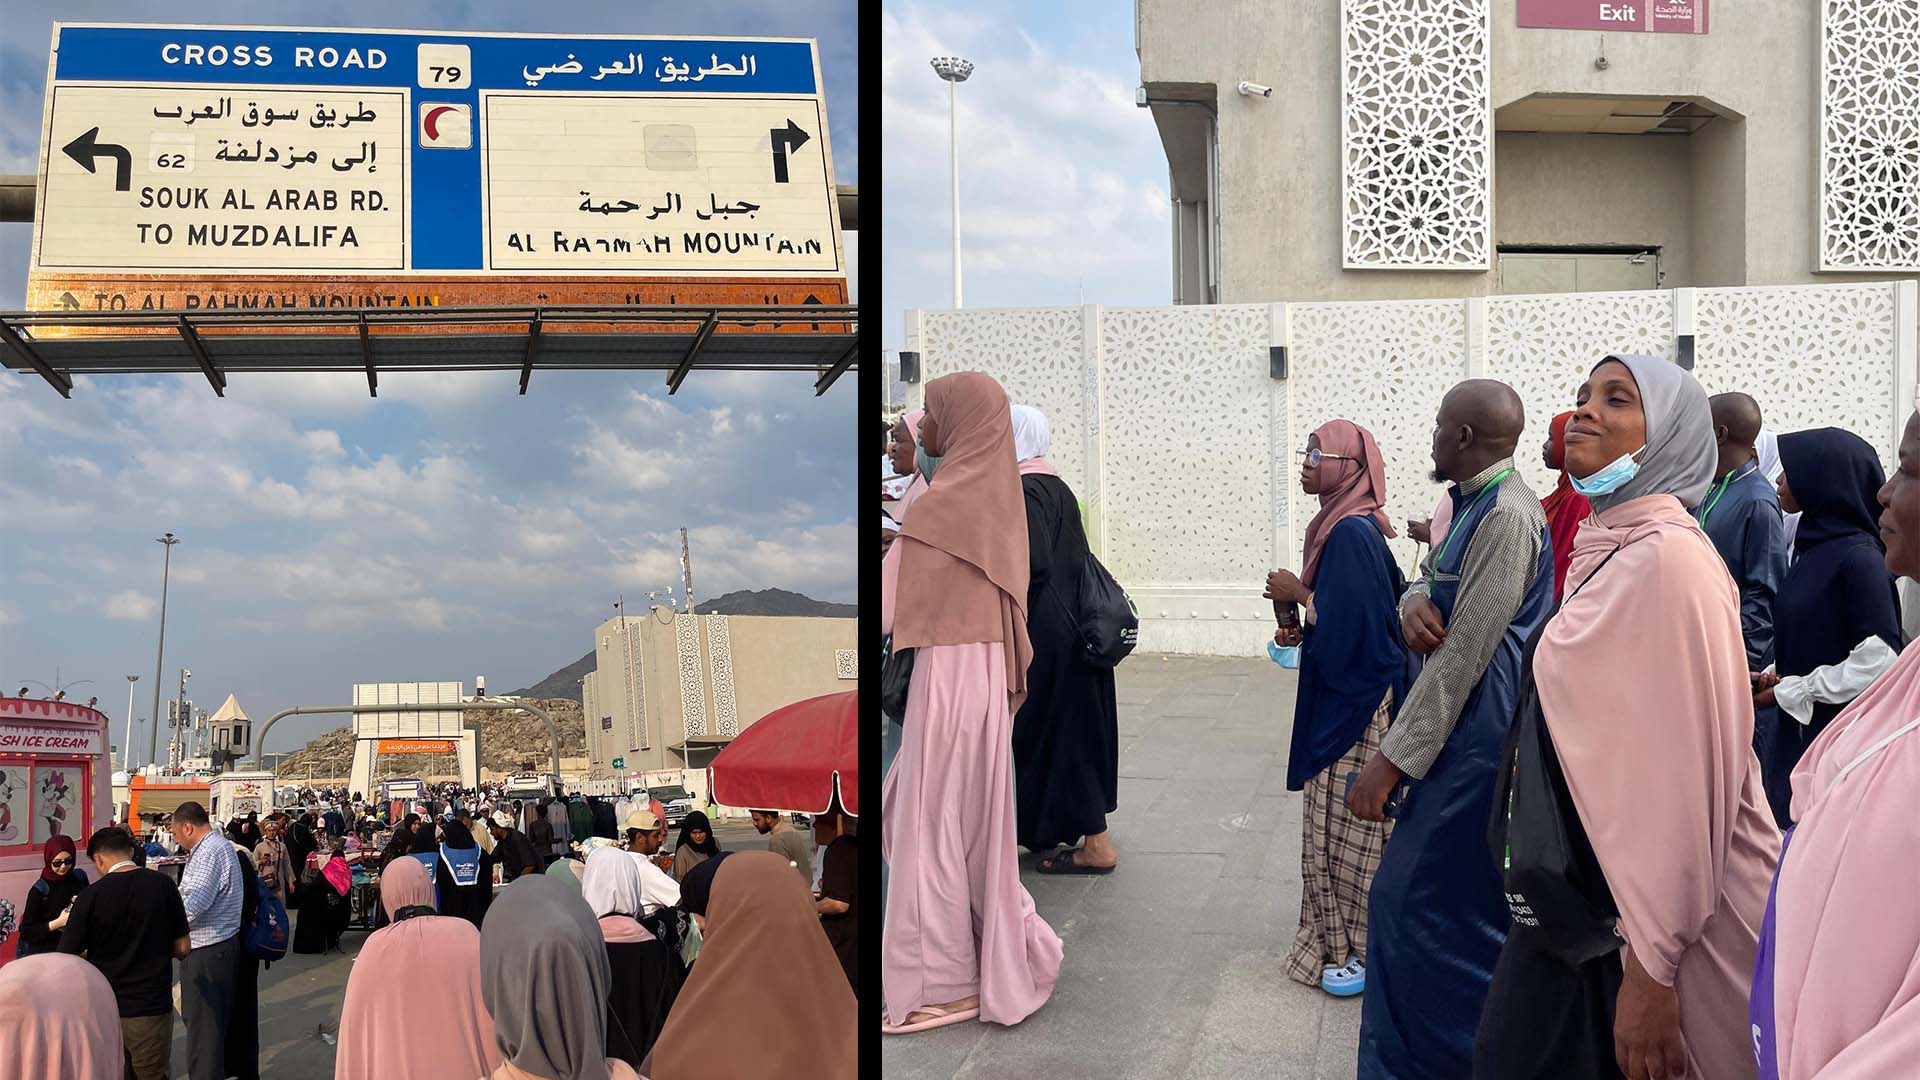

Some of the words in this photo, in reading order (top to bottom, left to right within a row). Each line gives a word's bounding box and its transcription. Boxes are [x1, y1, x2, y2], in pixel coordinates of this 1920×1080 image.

[1600, 4, 1636, 22] Exit
[162, 43, 273, 66] CROSS
[295, 47, 387, 69] ROAD
[429, 66, 462, 83] 79
[655, 53, 757, 84] الطريق
[153, 97, 231, 128] العرب
[241, 105, 299, 128] سوق
[309, 101, 377, 128] طريق
[156, 154, 185, 169] 62
[215, 138, 318, 168] مزدلفة
[331, 141, 377, 174] إلى
[139, 187, 209, 209] SOUK
[221, 189, 255, 210] AL
[266, 189, 338, 211] ARAB
[351, 191, 389, 211] RD.
[578, 190, 682, 220] الرحمة
[696, 192, 761, 220] جبل
[137, 224, 173, 245] TO
[188, 224, 359, 247] MUZDALIFA
[507, 233, 536, 252] AL
[94, 293, 127, 311] TO
[309, 293, 438, 310] MOUNTAIN
[0, 734, 21, 746] SH
[23, 736, 44, 747] ICE
[45, 737, 89, 748] CREAM
